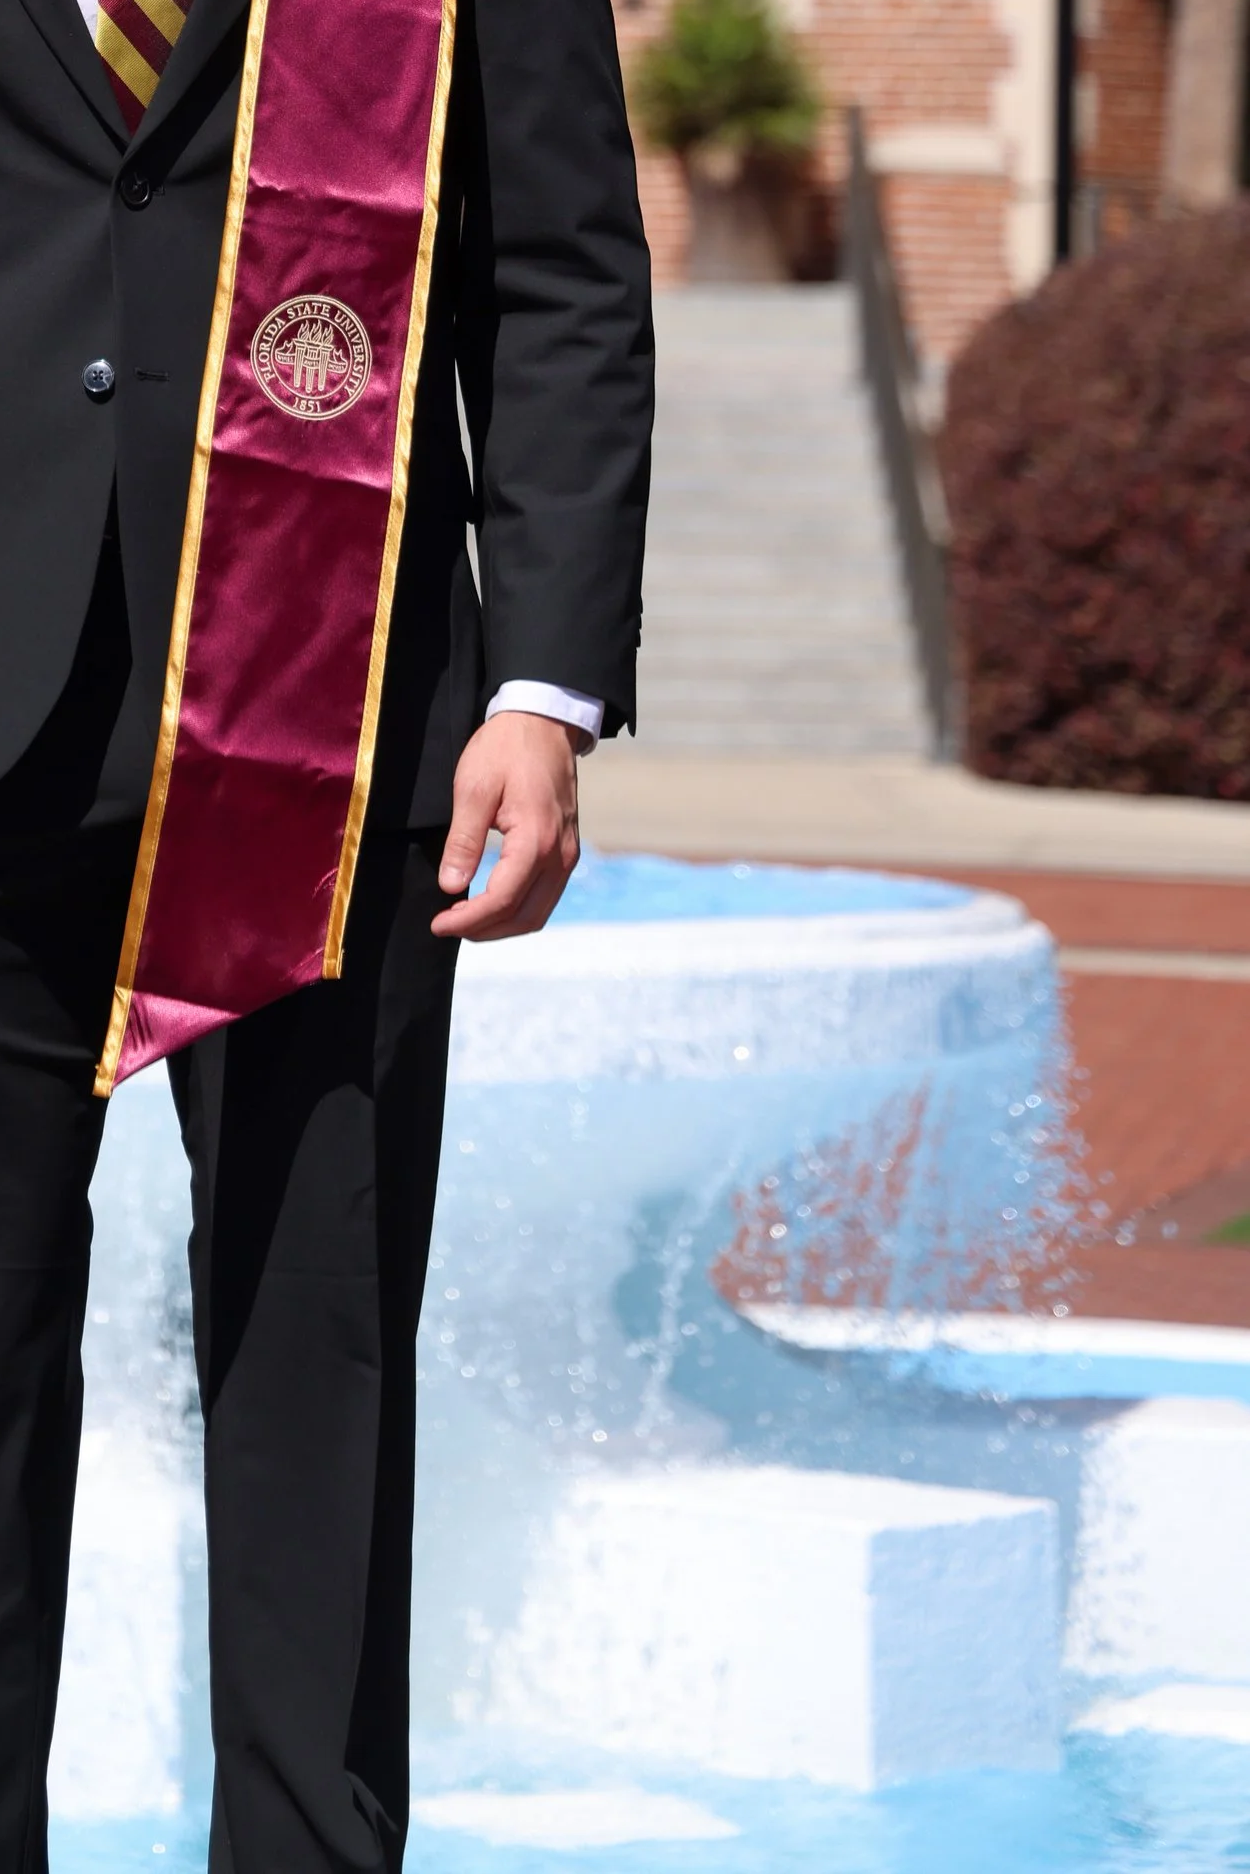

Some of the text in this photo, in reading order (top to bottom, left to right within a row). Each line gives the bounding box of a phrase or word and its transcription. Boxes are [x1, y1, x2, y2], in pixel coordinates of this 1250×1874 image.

[258, 302, 365, 397] FLORIDA STATE UNIVERSITY
[292, 398, 322, 414] 1851
